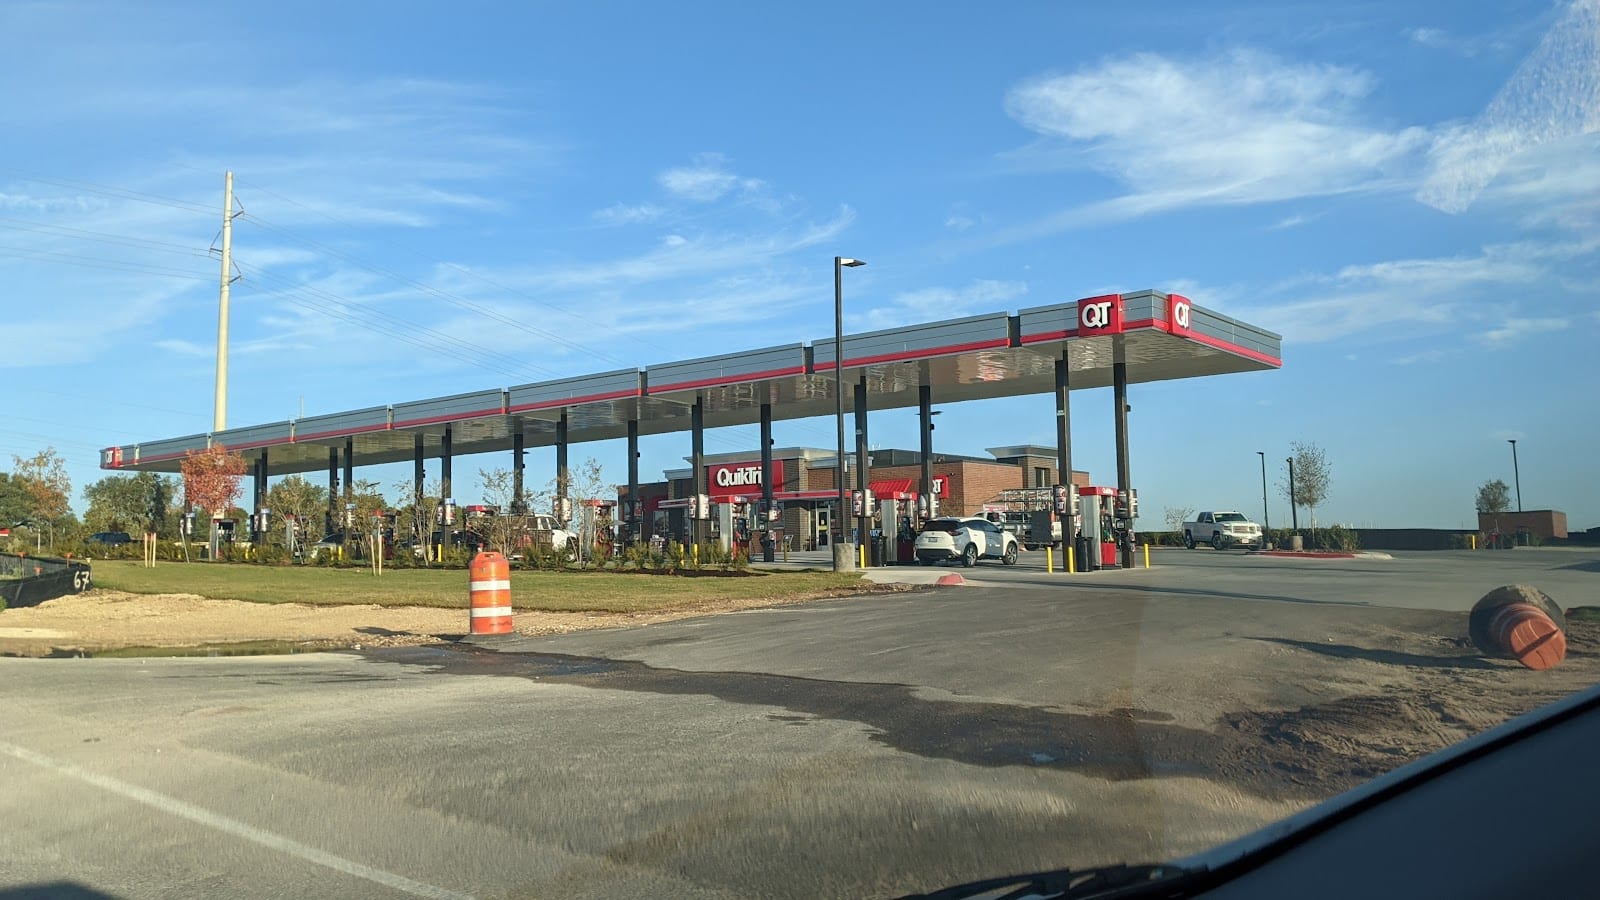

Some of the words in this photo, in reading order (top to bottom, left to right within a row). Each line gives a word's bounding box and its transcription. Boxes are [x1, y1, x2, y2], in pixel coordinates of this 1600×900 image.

[1082, 301, 1112, 328] QT
[1174, 301, 1190, 329] QT
[716, 466, 763, 487] QuikTri
[74, 571, 90, 592] 67
